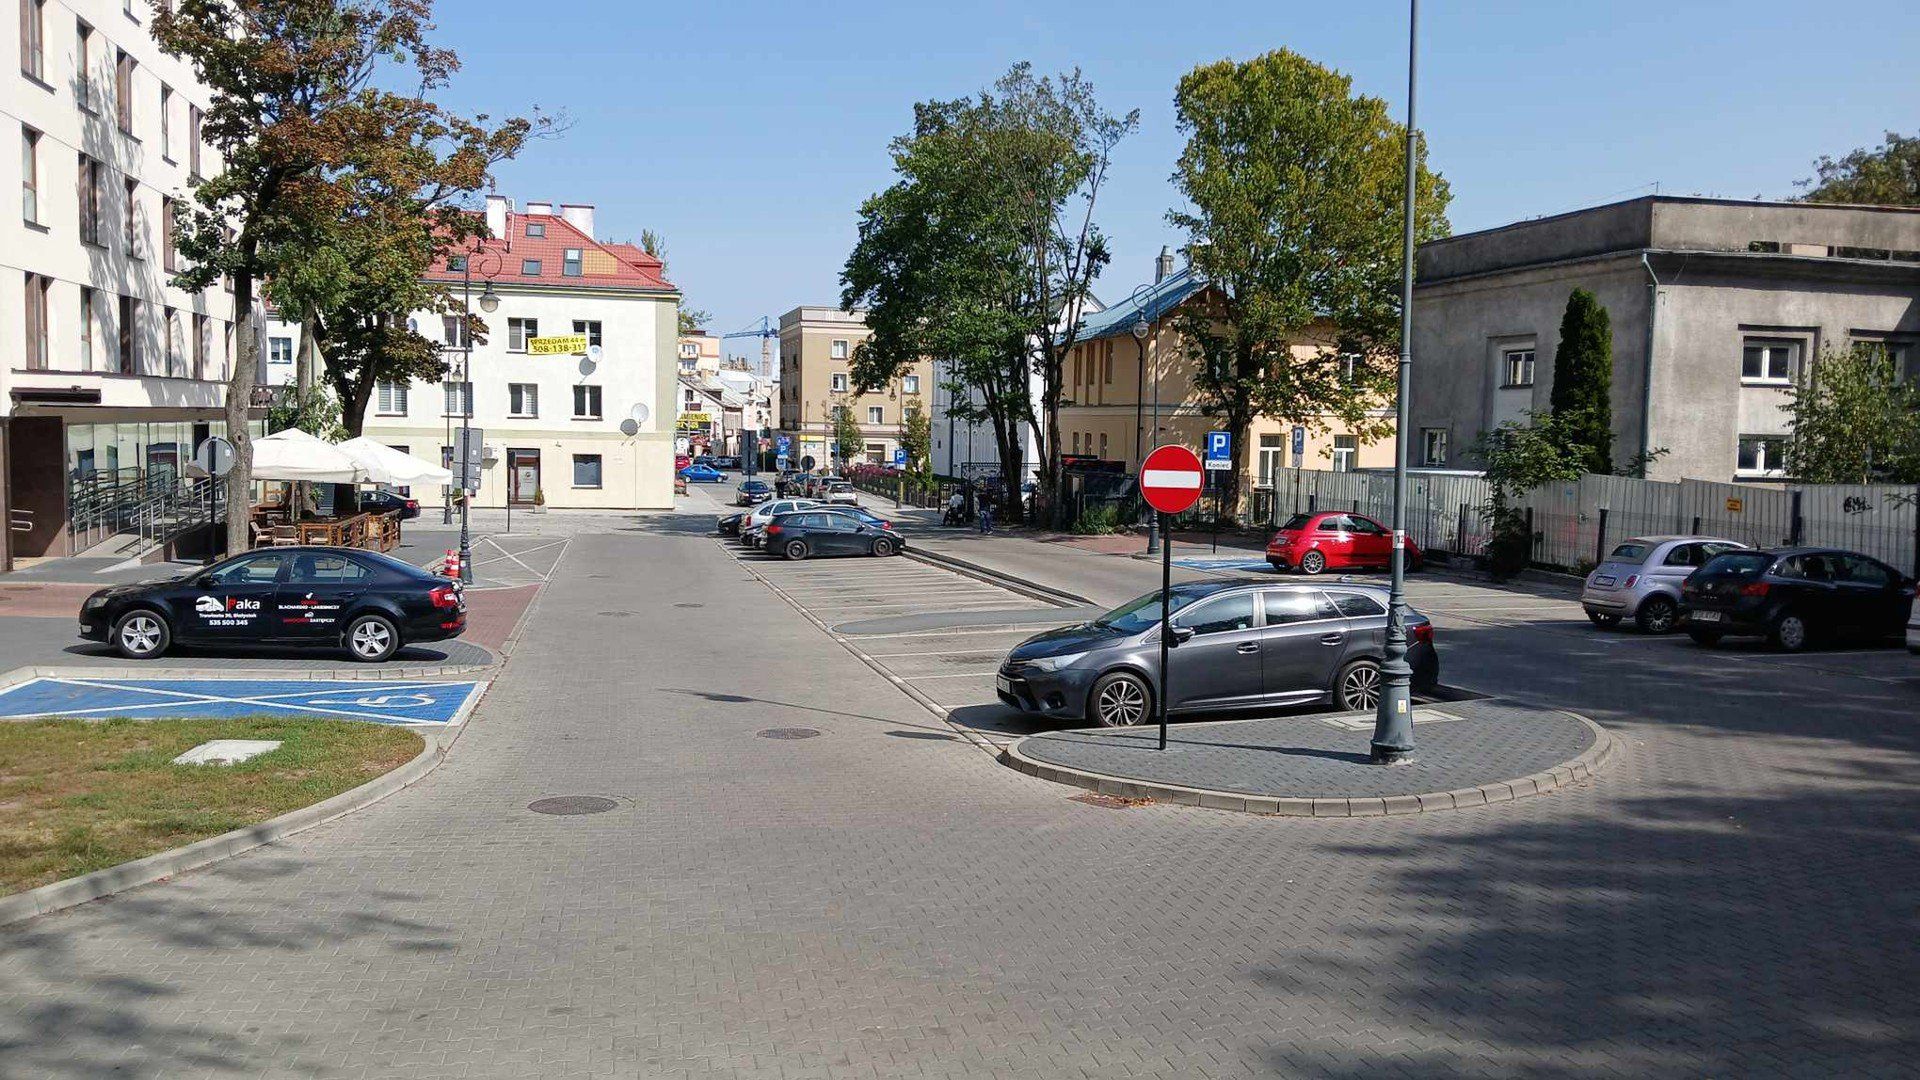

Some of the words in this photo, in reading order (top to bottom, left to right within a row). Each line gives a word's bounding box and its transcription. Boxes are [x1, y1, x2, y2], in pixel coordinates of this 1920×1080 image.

[1213, 435, 1226, 453] P
[1295, 428, 1302, 445] P
[896, 450, 904, 459] P
[228, 597, 261, 610] Paka
